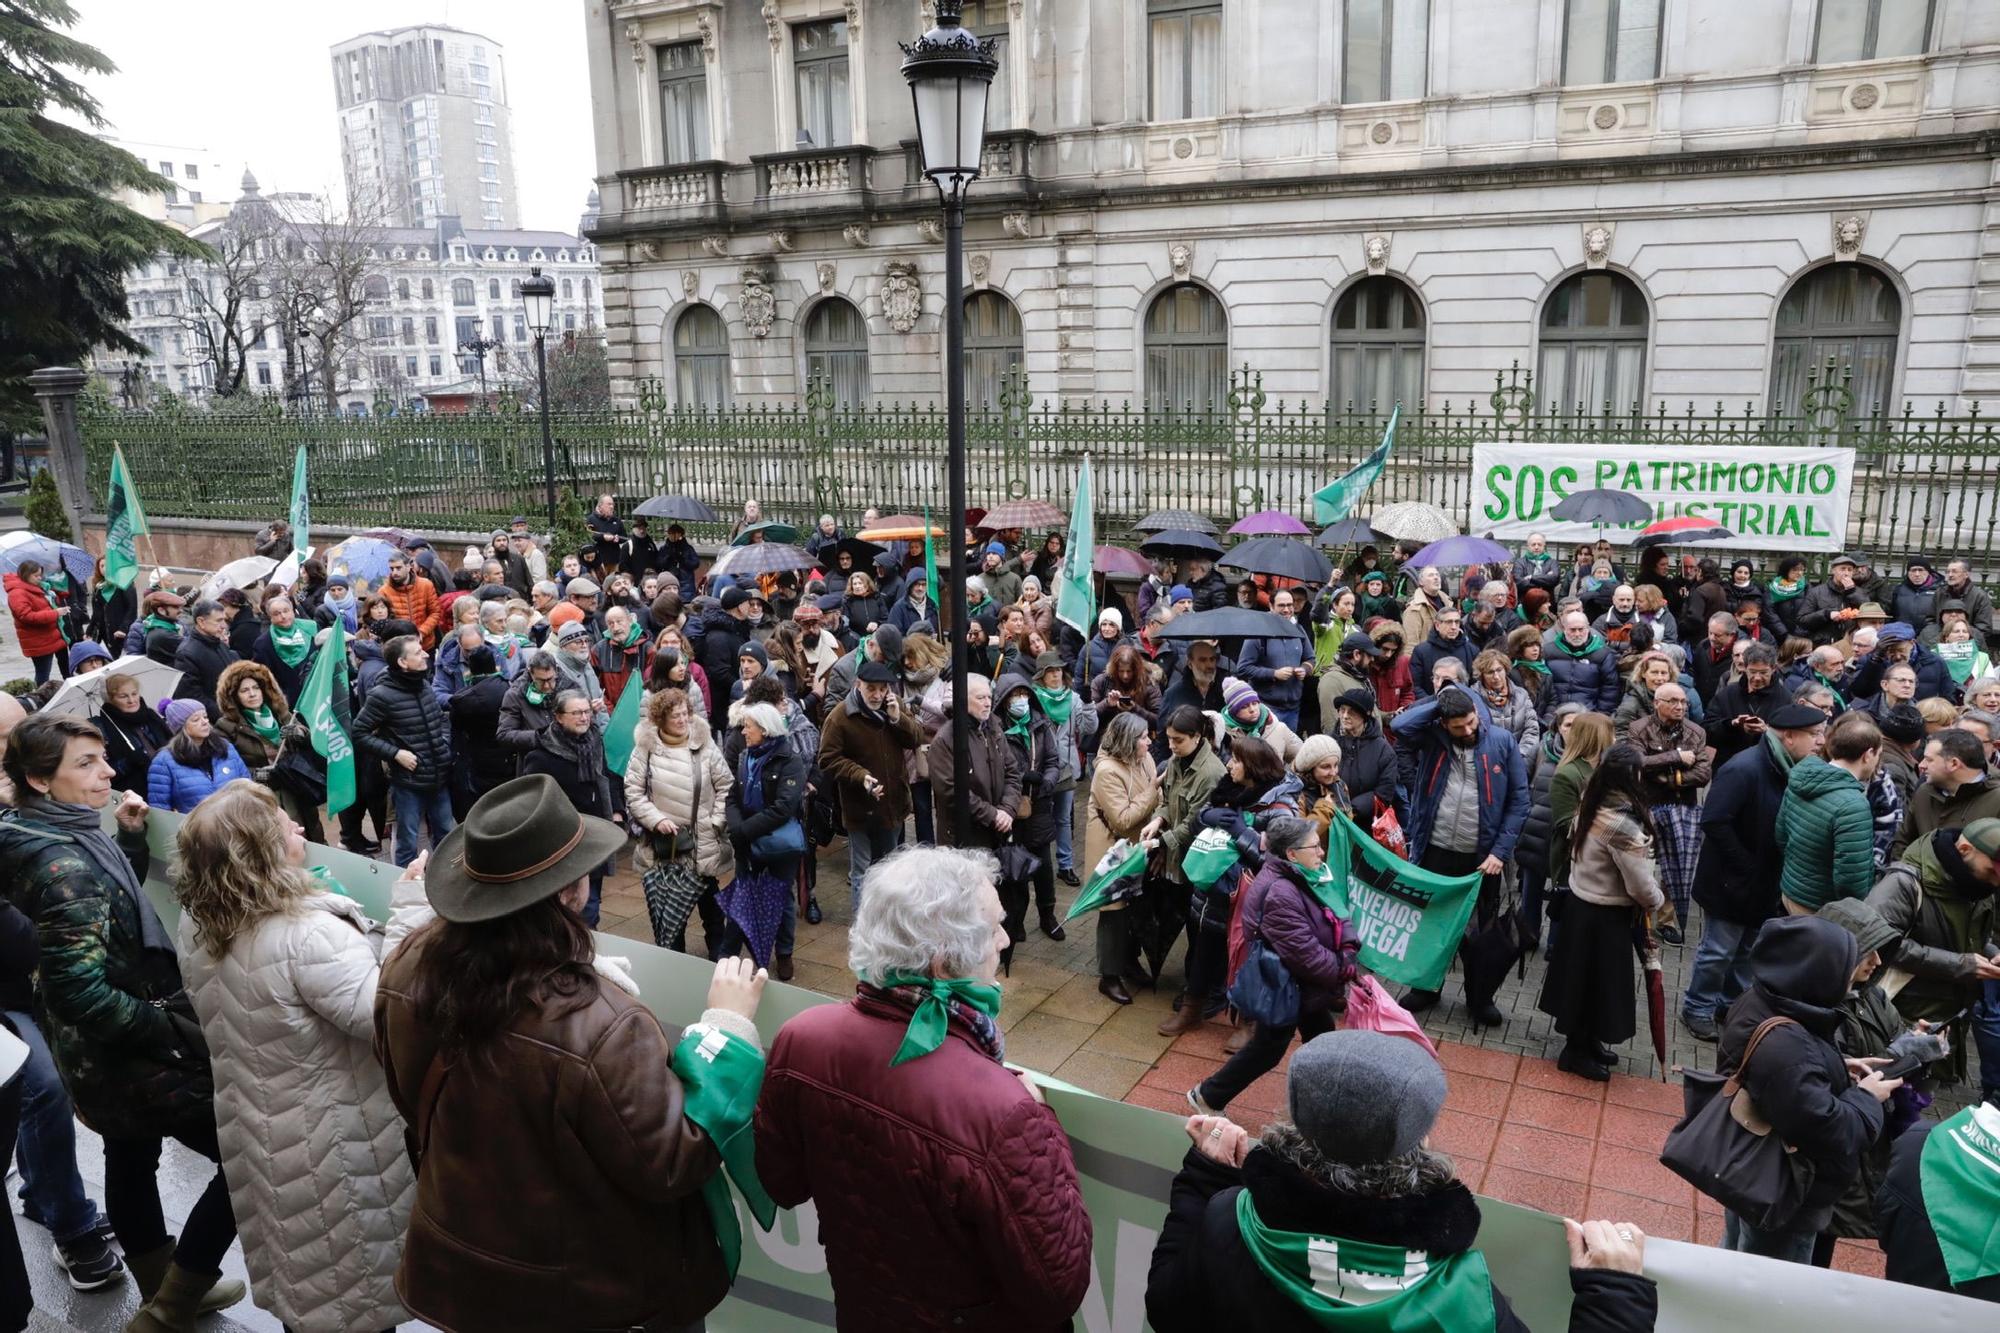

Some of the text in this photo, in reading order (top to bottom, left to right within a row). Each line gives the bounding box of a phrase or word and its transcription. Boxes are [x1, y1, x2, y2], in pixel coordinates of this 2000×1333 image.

[1484, 459, 1836, 522] SOS PATRIMONIO
[1592, 501, 1831, 536] USTRIAL
